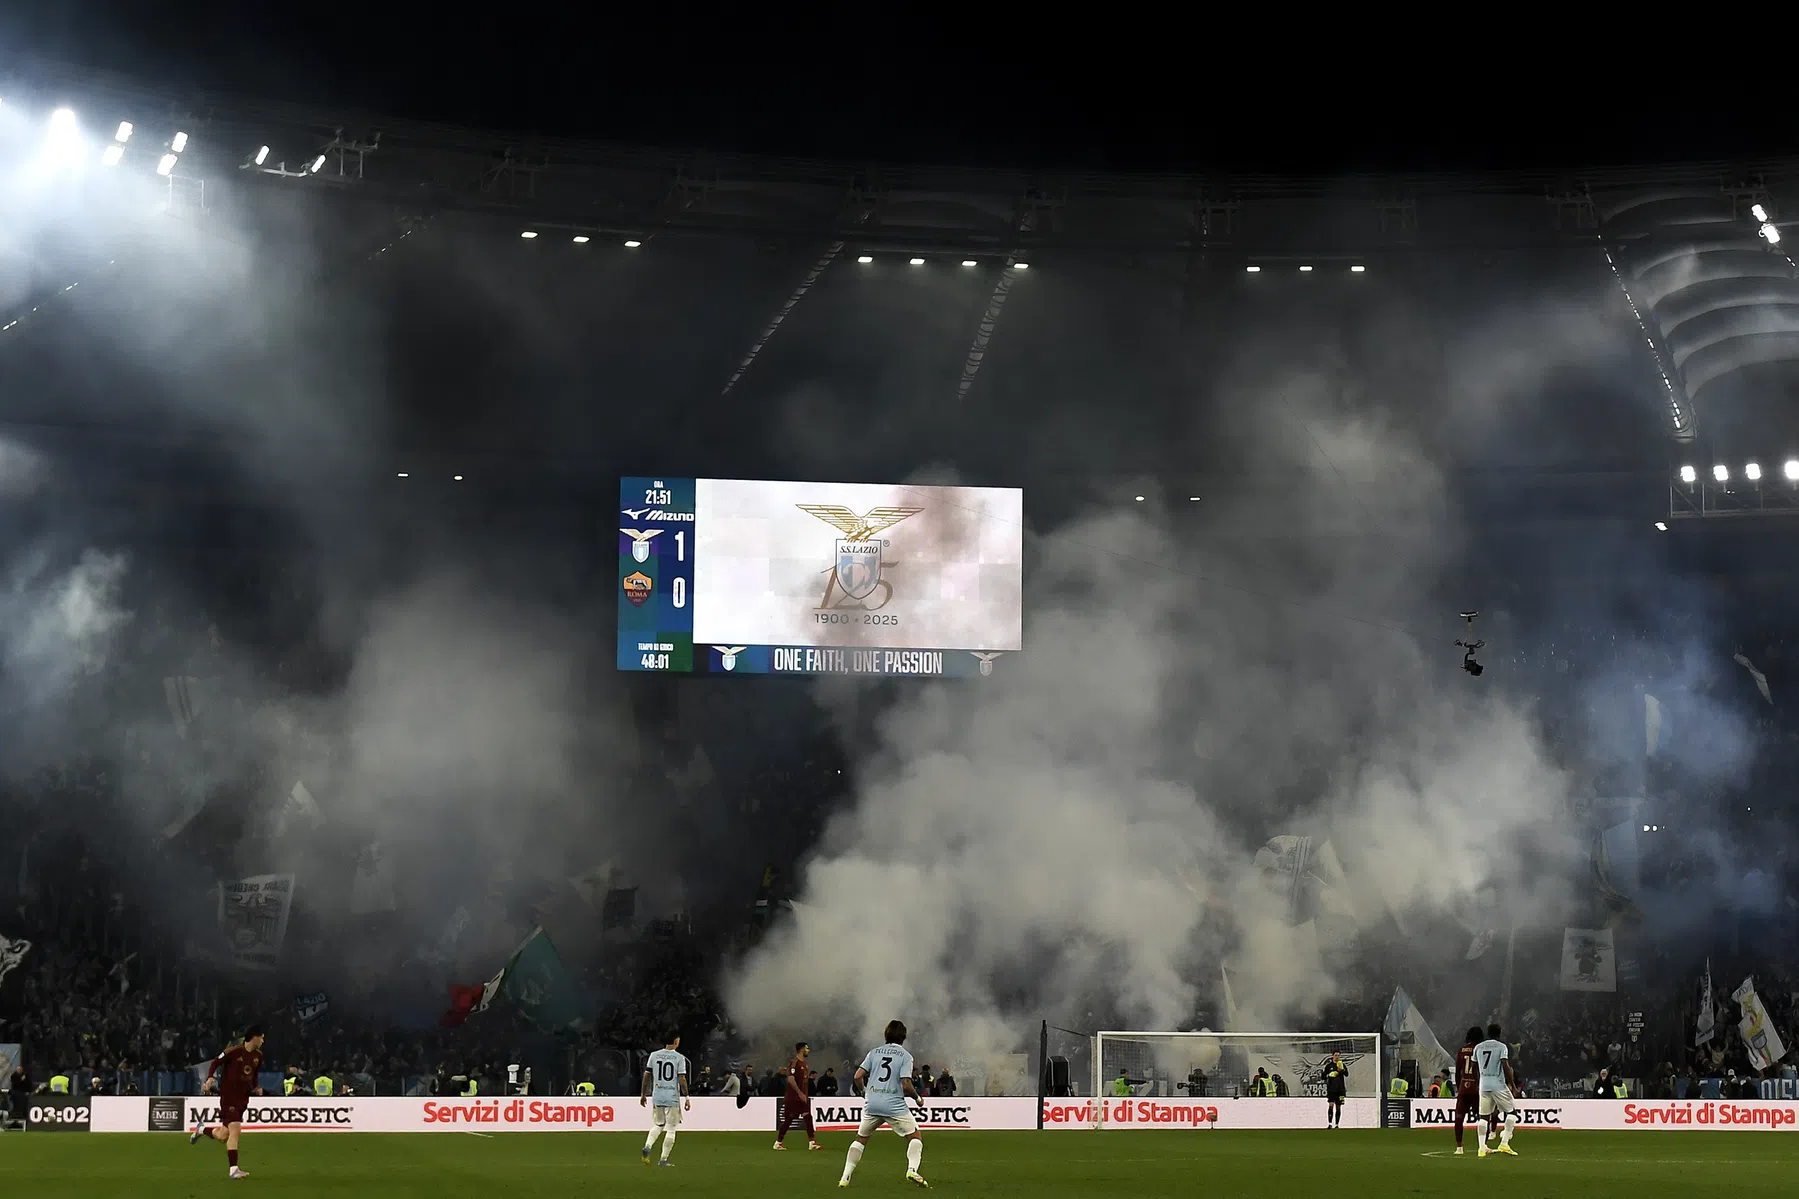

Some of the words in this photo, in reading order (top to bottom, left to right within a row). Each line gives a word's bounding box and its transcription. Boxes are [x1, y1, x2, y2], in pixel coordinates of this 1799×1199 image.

[645, 489, 671, 505] 21:51
[674, 530, 685, 562] 1
[627, 590, 648, 598] ROMA
[672, 576, 686, 609] 0
[814, 613, 850, 624] 1900
[863, 614, 899, 626] 2025
[641, 653, 670, 669] 48:01
[774, 648, 802, 671] ONE
[806, 649, 849, 674] FAITH,
[853, 650, 881, 673] ONE
[884, 651, 943, 674] PASSION
[1482, 1050, 1493, 1070] 7
[656, 1060, 674, 1082] 10
[877, 1056, 893, 1083] 3
[1304, 1089, 1328, 1097] AZIO
[29, 1106, 89, 1123] 03:02
[155, 1110, 179, 1119] MBE
[247, 1107, 308, 1123] BOXES
[423, 1100, 499, 1123] Servizi
[504, 1100, 525, 1123] di
[529, 1101, 615, 1128] Stampa
[1113, 1100, 1134, 1123] di
[1137, 1101, 1219, 1127] Stampa
[1415, 1108, 1457, 1124] MAI
[1624, 1102, 1692, 1124] Servizi
[1696, 1102, 1715, 1124] di
[1719, 1103, 1796, 1129] Stampa
